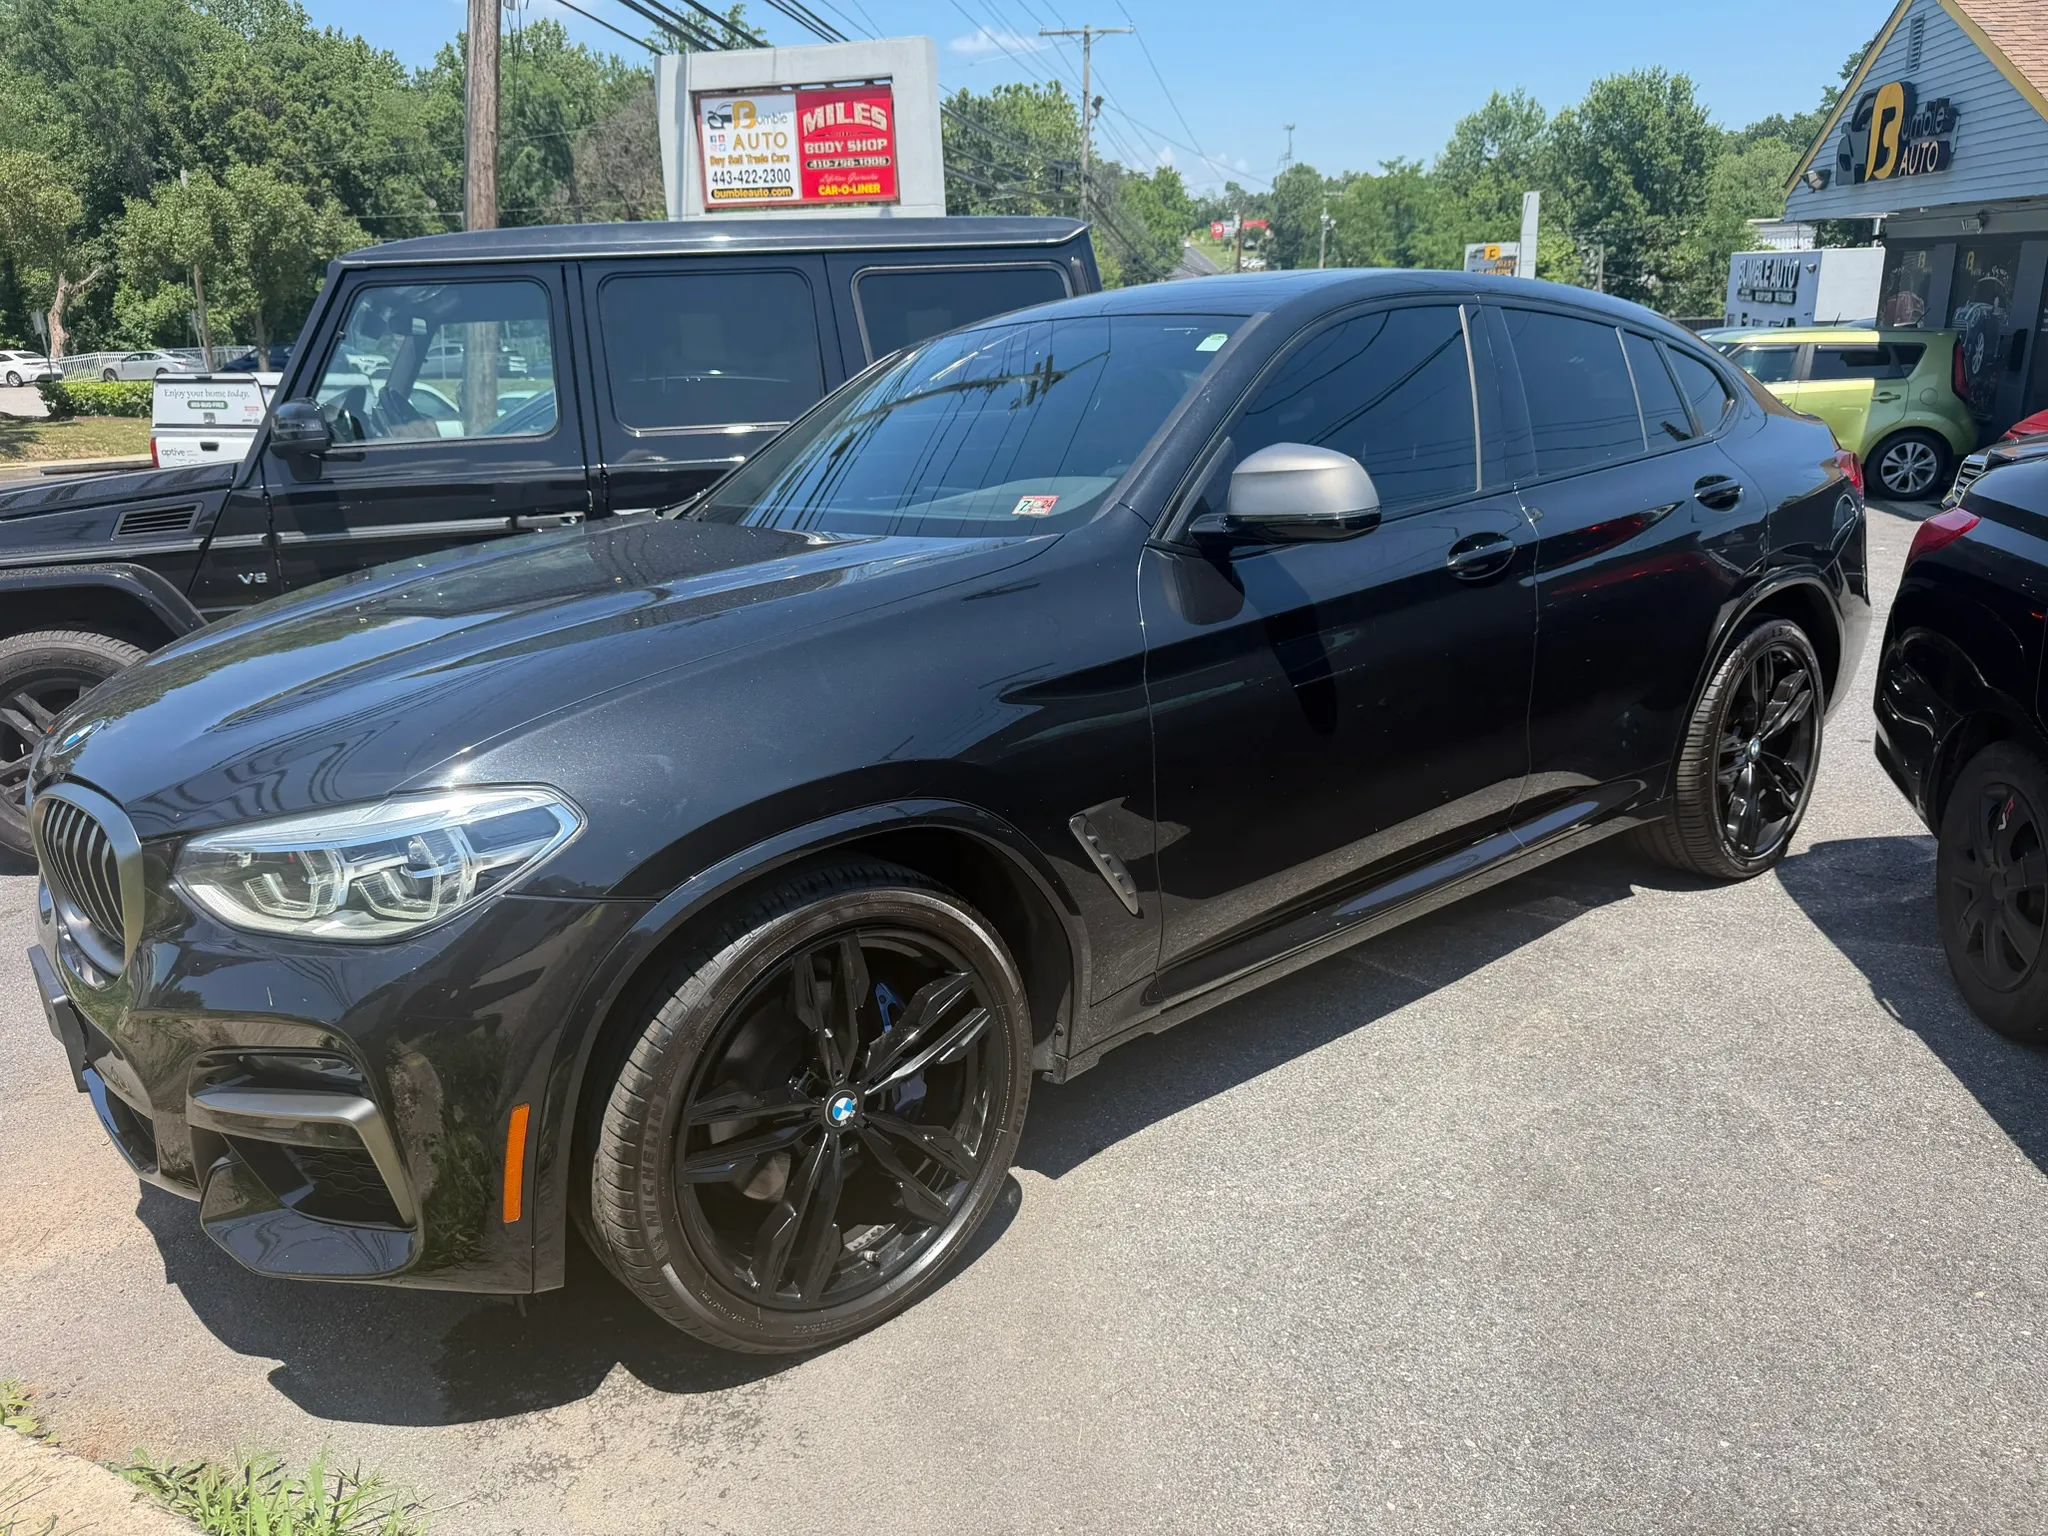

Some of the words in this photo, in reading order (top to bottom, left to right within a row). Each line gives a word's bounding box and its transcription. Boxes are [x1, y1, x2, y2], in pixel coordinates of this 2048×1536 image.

[802, 102, 888, 138] MILES
[733, 132, 788, 151] AUTO
[804, 141, 844, 154] BODY
[847, 138, 888, 152] SHOP
[1898, 141, 1939, 176] AUTO
[712, 168, 791, 185] 443-422-2300
[714, 188, 792, 199] bumbleauto.com
[818, 183, 881, 196] CAR-O-LINER
[164, 389, 185, 399] Enjoy
[186, 391, 203, 399] your
[205, 389, 225, 397] home
